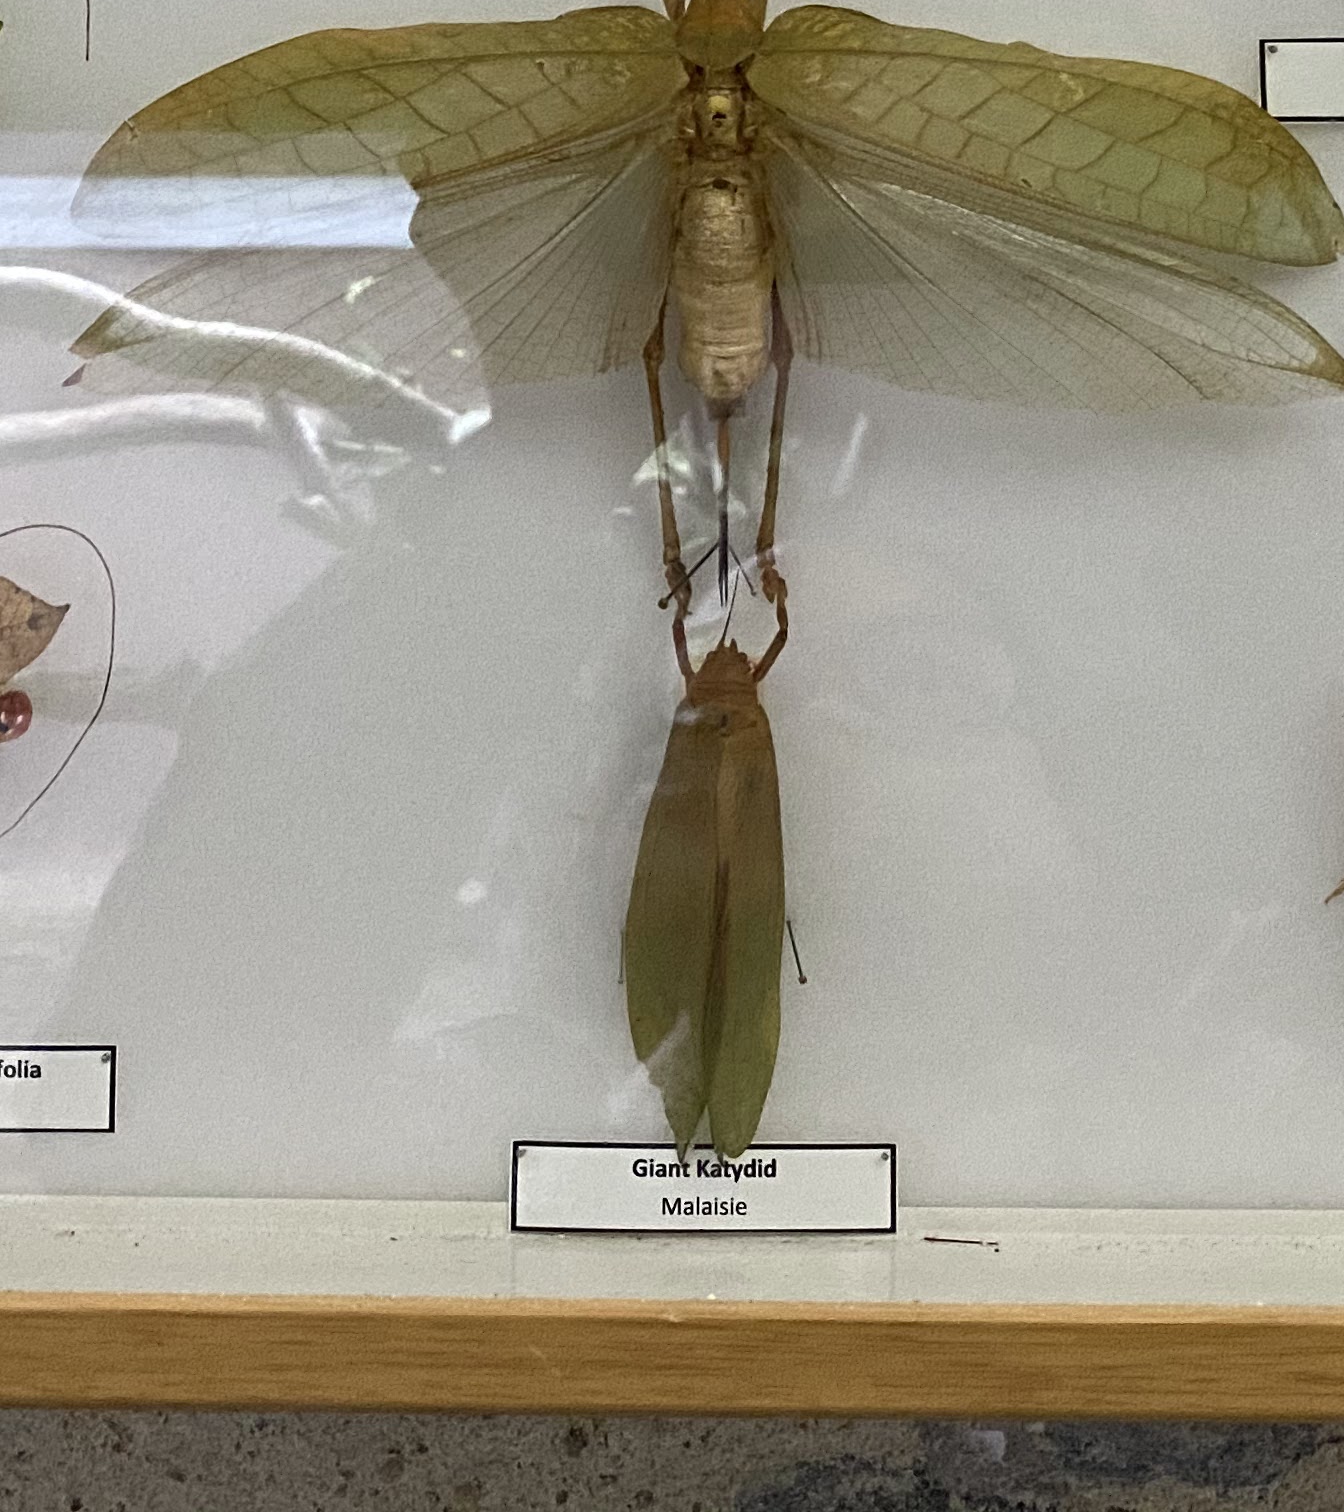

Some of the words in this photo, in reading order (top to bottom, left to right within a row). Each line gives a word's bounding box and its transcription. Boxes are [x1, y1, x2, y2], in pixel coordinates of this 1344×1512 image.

[632, 1158, 690, 1178] Giant
[697, 1158, 777, 1183] Katydid
[661, 1197, 747, 1216] Malaisie
